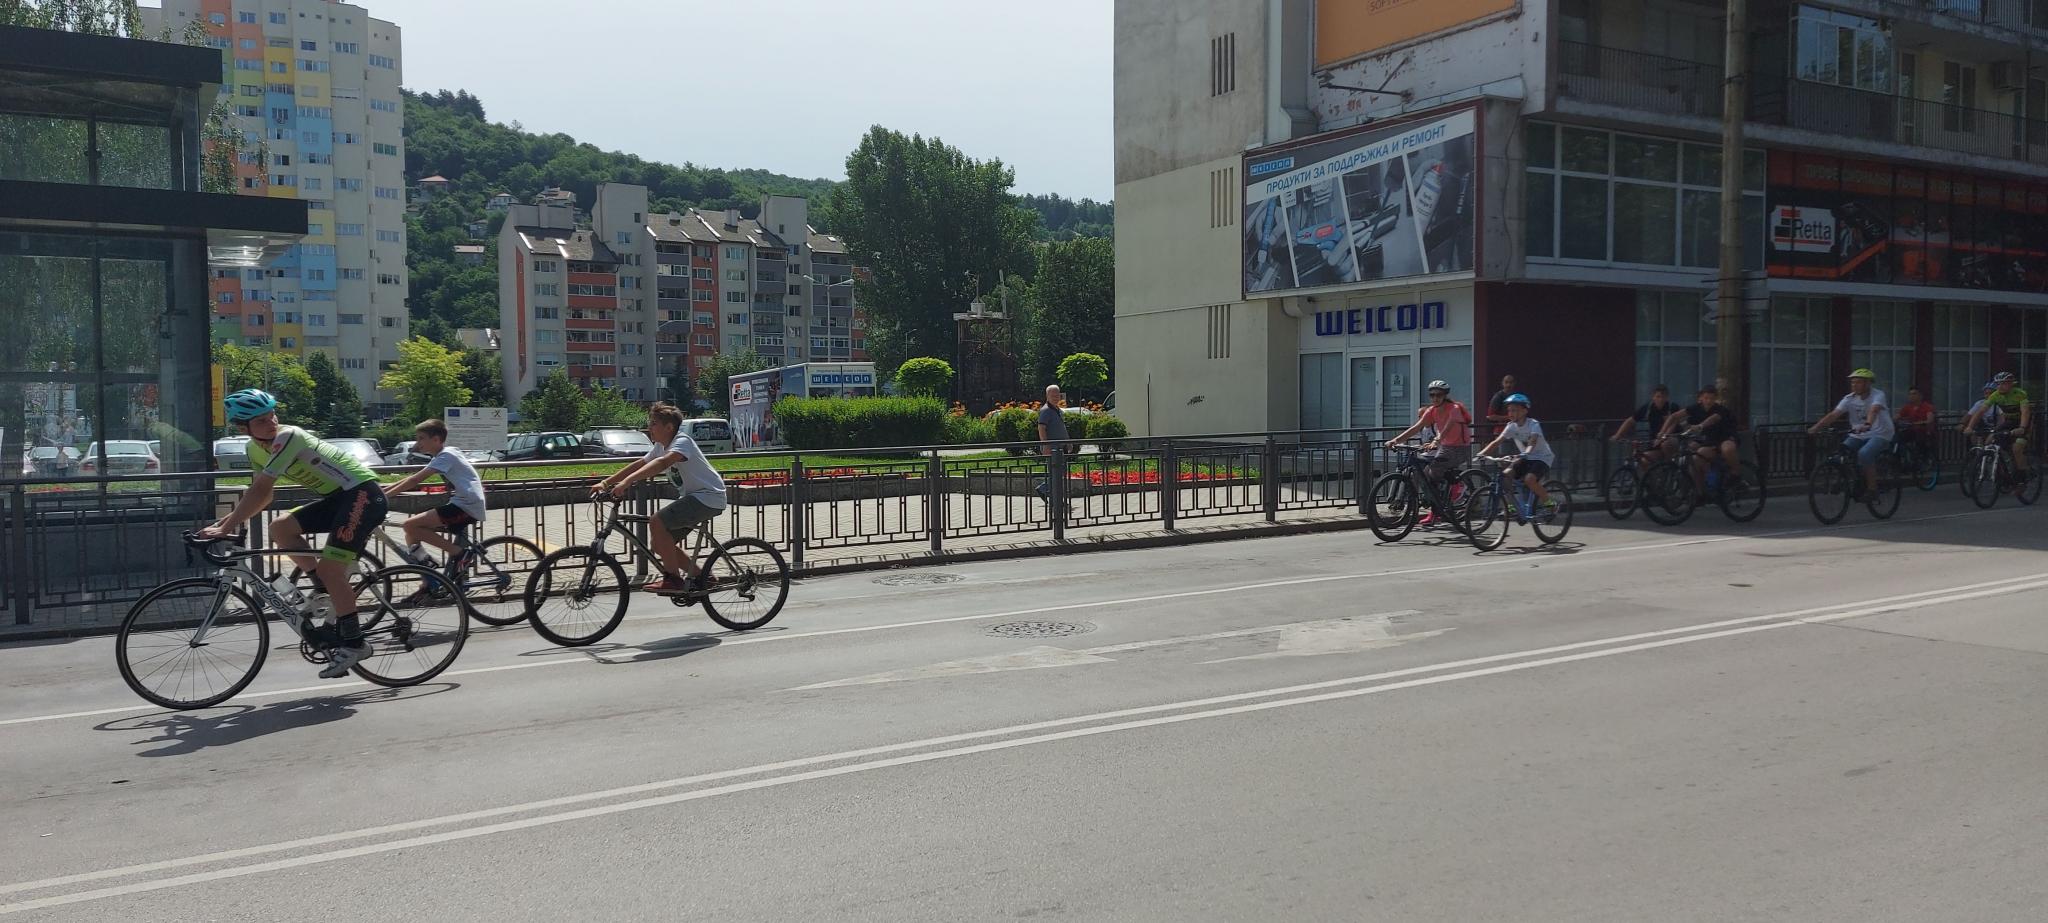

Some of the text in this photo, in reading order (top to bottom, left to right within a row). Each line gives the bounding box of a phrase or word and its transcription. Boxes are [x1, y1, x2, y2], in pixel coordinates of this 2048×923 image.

[1266, 124, 1447, 194] ПРОДУКТИ ЗА ПОДДРЪЖКА И РЕМОНТ
[1791, 219, 1832, 240] Retta
[1315, 301, 1445, 337] WEICON
[249, 578, 297, 627] KUOTA
